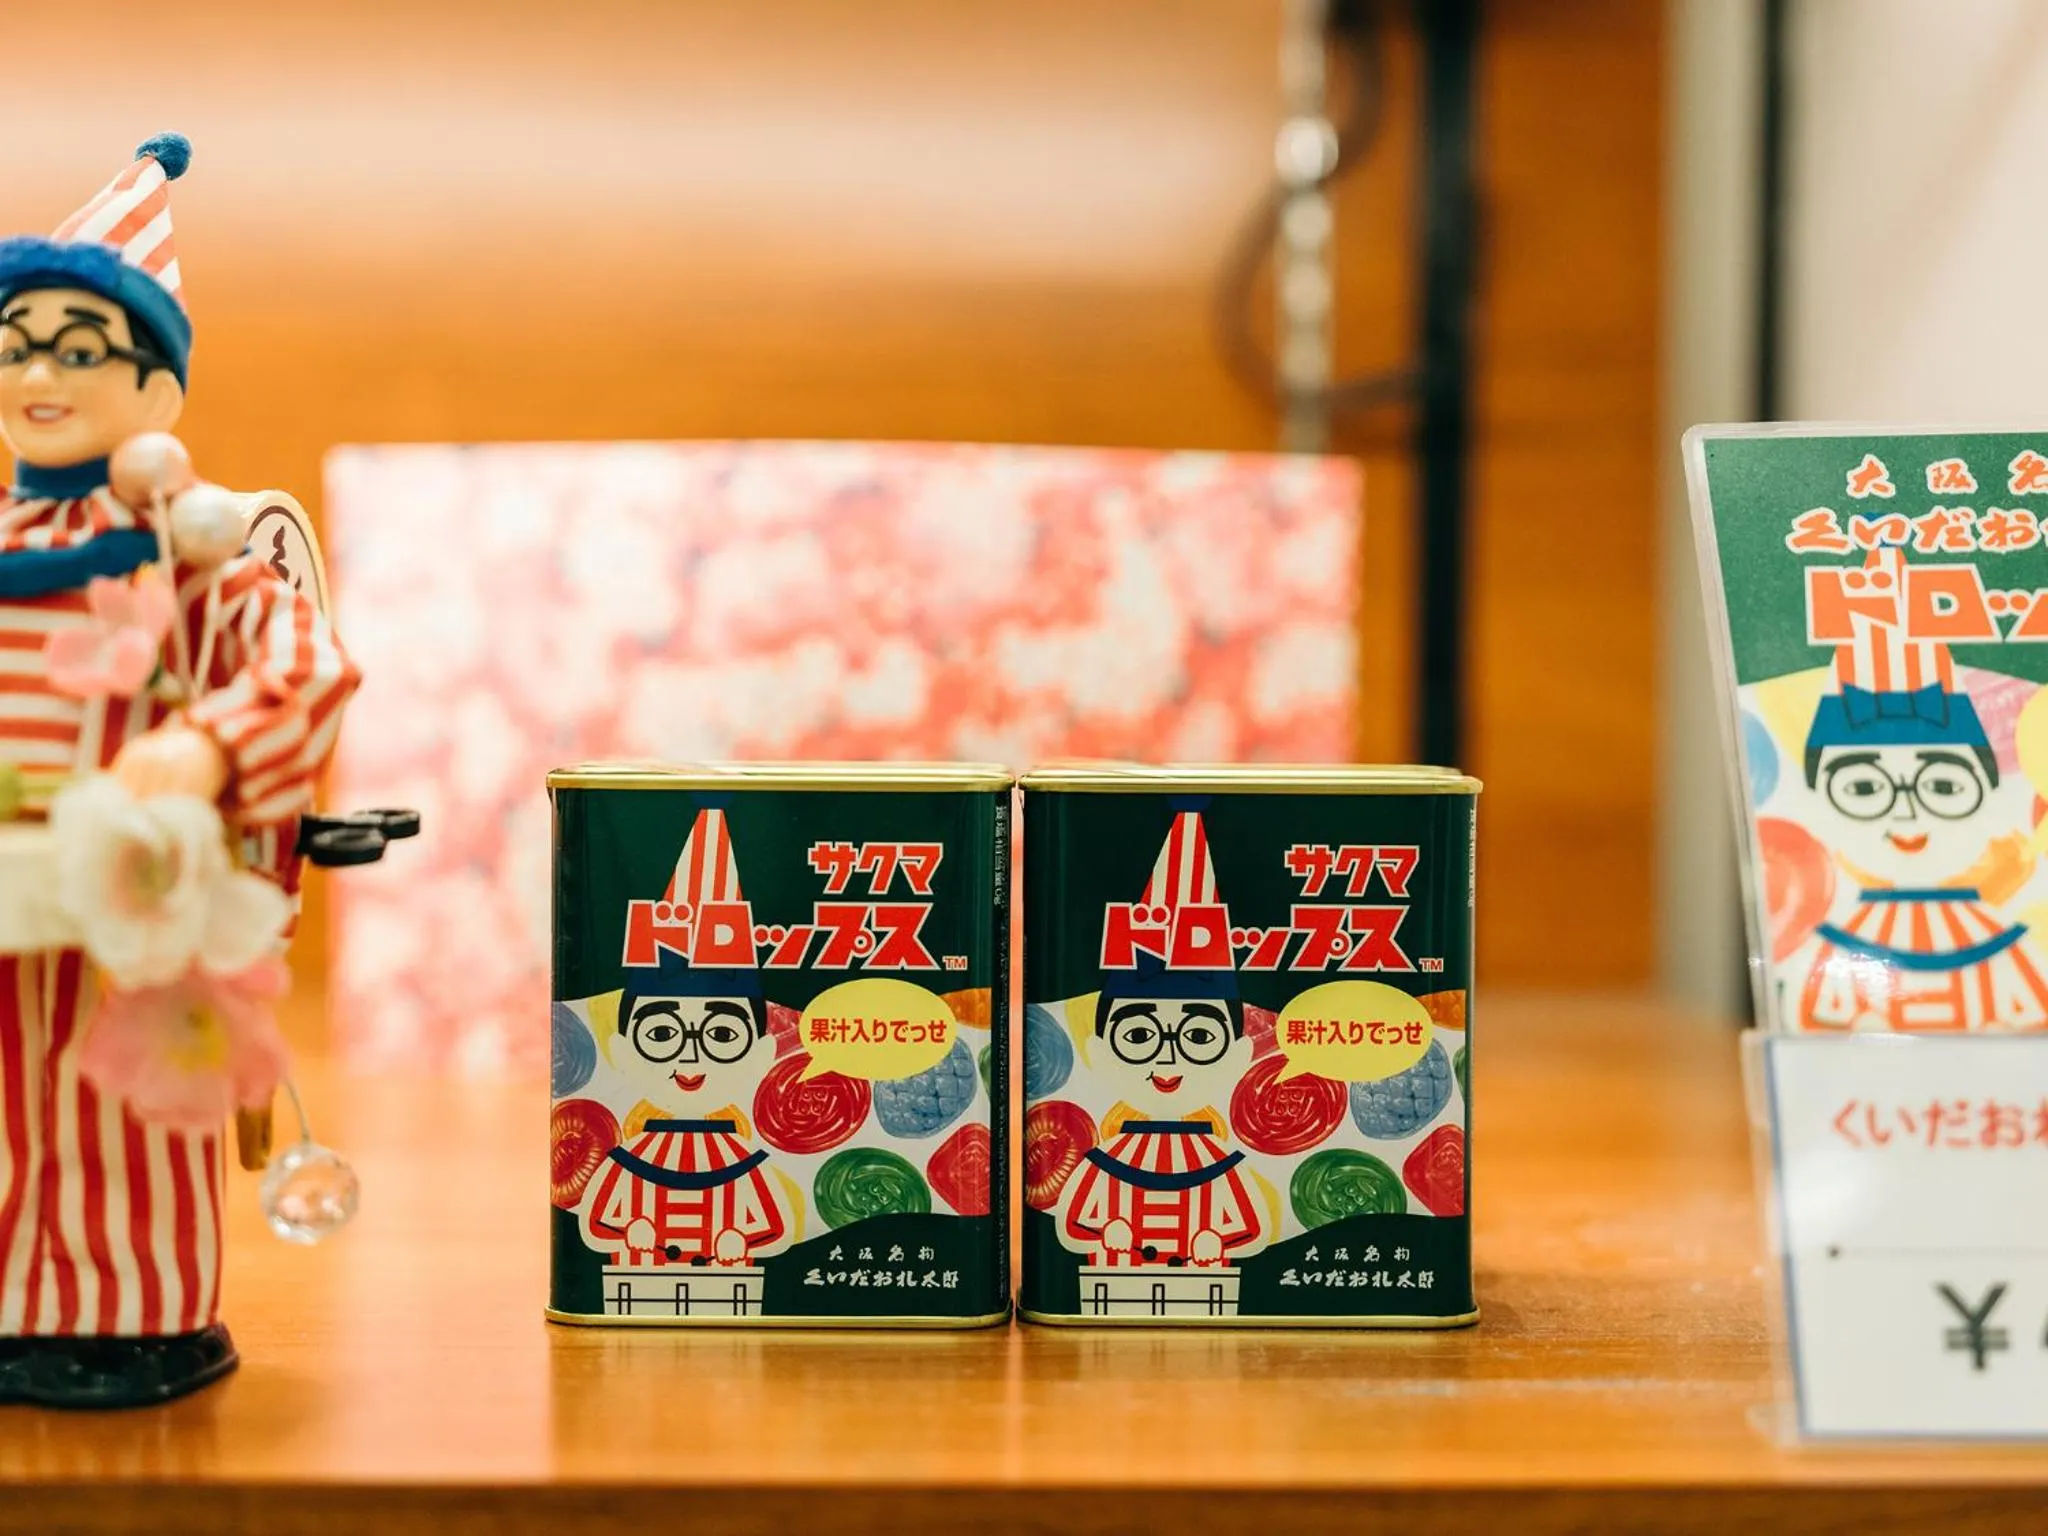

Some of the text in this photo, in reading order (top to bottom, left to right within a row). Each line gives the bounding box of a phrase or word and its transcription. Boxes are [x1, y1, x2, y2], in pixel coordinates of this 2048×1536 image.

[1786, 506, 2048, 553] くいだお
[807, 841, 943, 895] サクマ
[1284, 844, 1420, 897] サクマ
[622, 899, 942, 970] ドロップス
[1099, 903, 1417, 973] ドロップス
[810, 1017, 947, 1044] 果汁入りでっせ
[1286, 1019, 1424, 1047] 果汁入りでっせ
[829, 1244, 935, 1262] 大阪名物
[1304, 1244, 1411, 1263] 大阪名物
[803, 1268, 960, 1289] くいだおれ太郎
[1279, 1268, 1435, 1289] くいだおれ太郎
